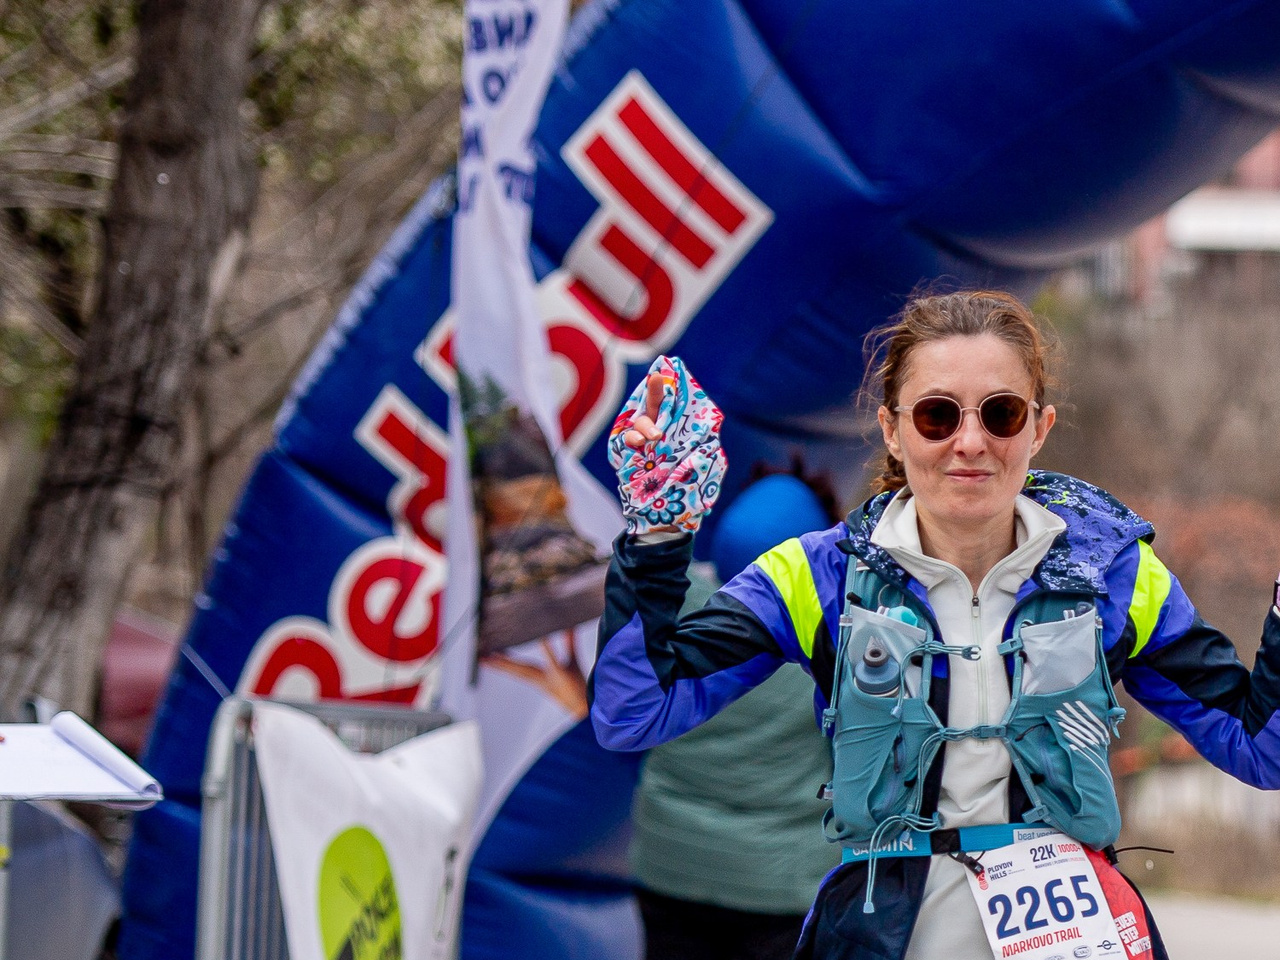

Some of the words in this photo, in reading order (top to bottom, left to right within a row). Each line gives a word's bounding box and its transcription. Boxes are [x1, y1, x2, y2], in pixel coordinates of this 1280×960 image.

[1030, 843, 1057, 862] 22K
[987, 861, 1013, 874] PLOVDIV
[990, 870, 1007, 881] HILLS
[988, 875, 1099, 940] 2265
[1002, 933, 1054, 958] MARKOVO
[1053, 927, 1083, 943] TRAIL
